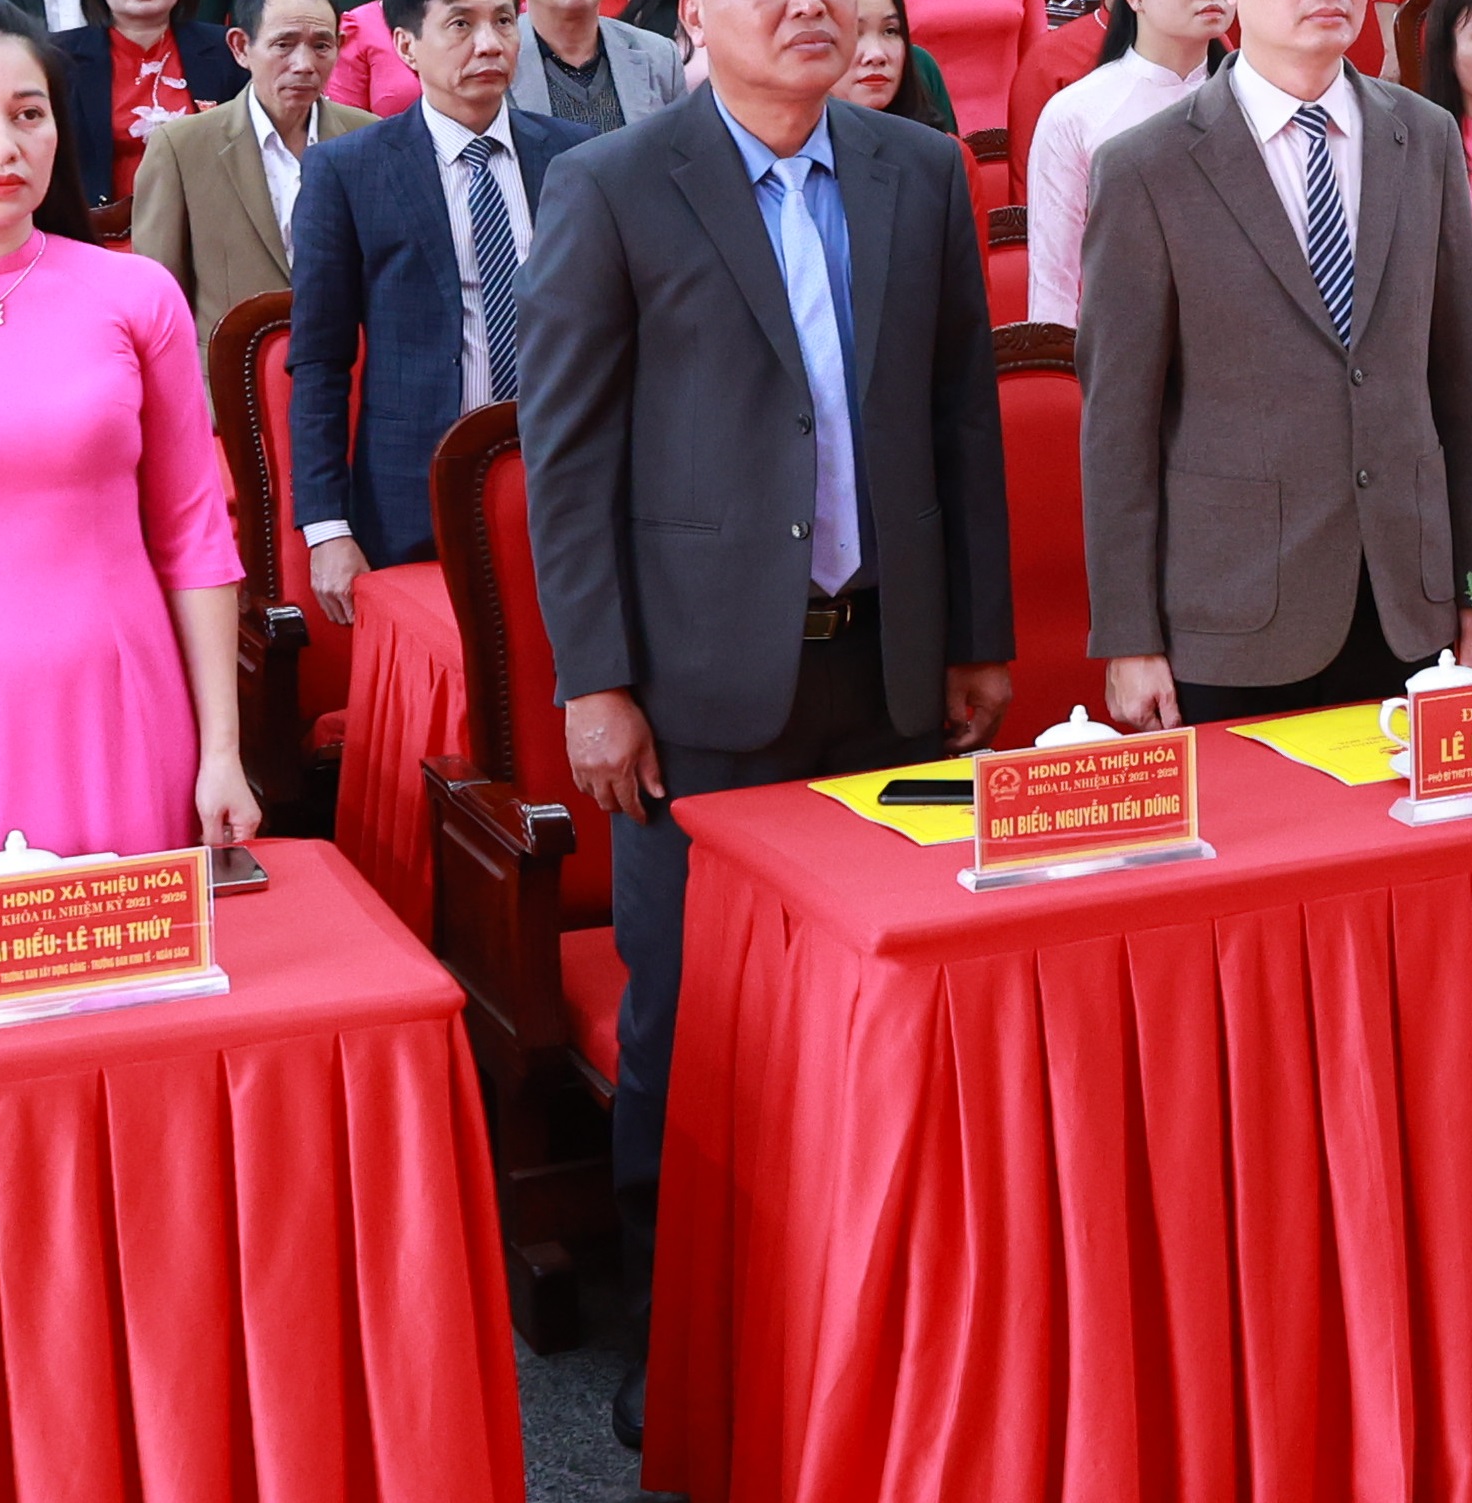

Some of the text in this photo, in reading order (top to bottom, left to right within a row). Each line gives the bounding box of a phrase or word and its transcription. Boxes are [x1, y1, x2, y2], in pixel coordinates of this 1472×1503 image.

[1029, 746, 1176, 780] HĐND XÃ THIỆU HÓA
[1440, 731, 1465, 763] LÊ
[1128, 771, 1149, 783] 2021
[991, 793, 1180, 841] ĐẠI BIỂU: NGUYỄN TIẾN DŨNG
[3, 869, 183, 909] HĐND XÃ THIỆU HÓA
[1, 910, 39, 927] KHÓA
[59, 901, 103, 920] NHIỆM
[126, 897, 151, 909] 2021
[13, 928, 61, 959] BIỂU:
[67, 925, 88, 952] LÊ
[95, 925, 123, 950] THỊ
[127, 915, 172, 943] THÚY
